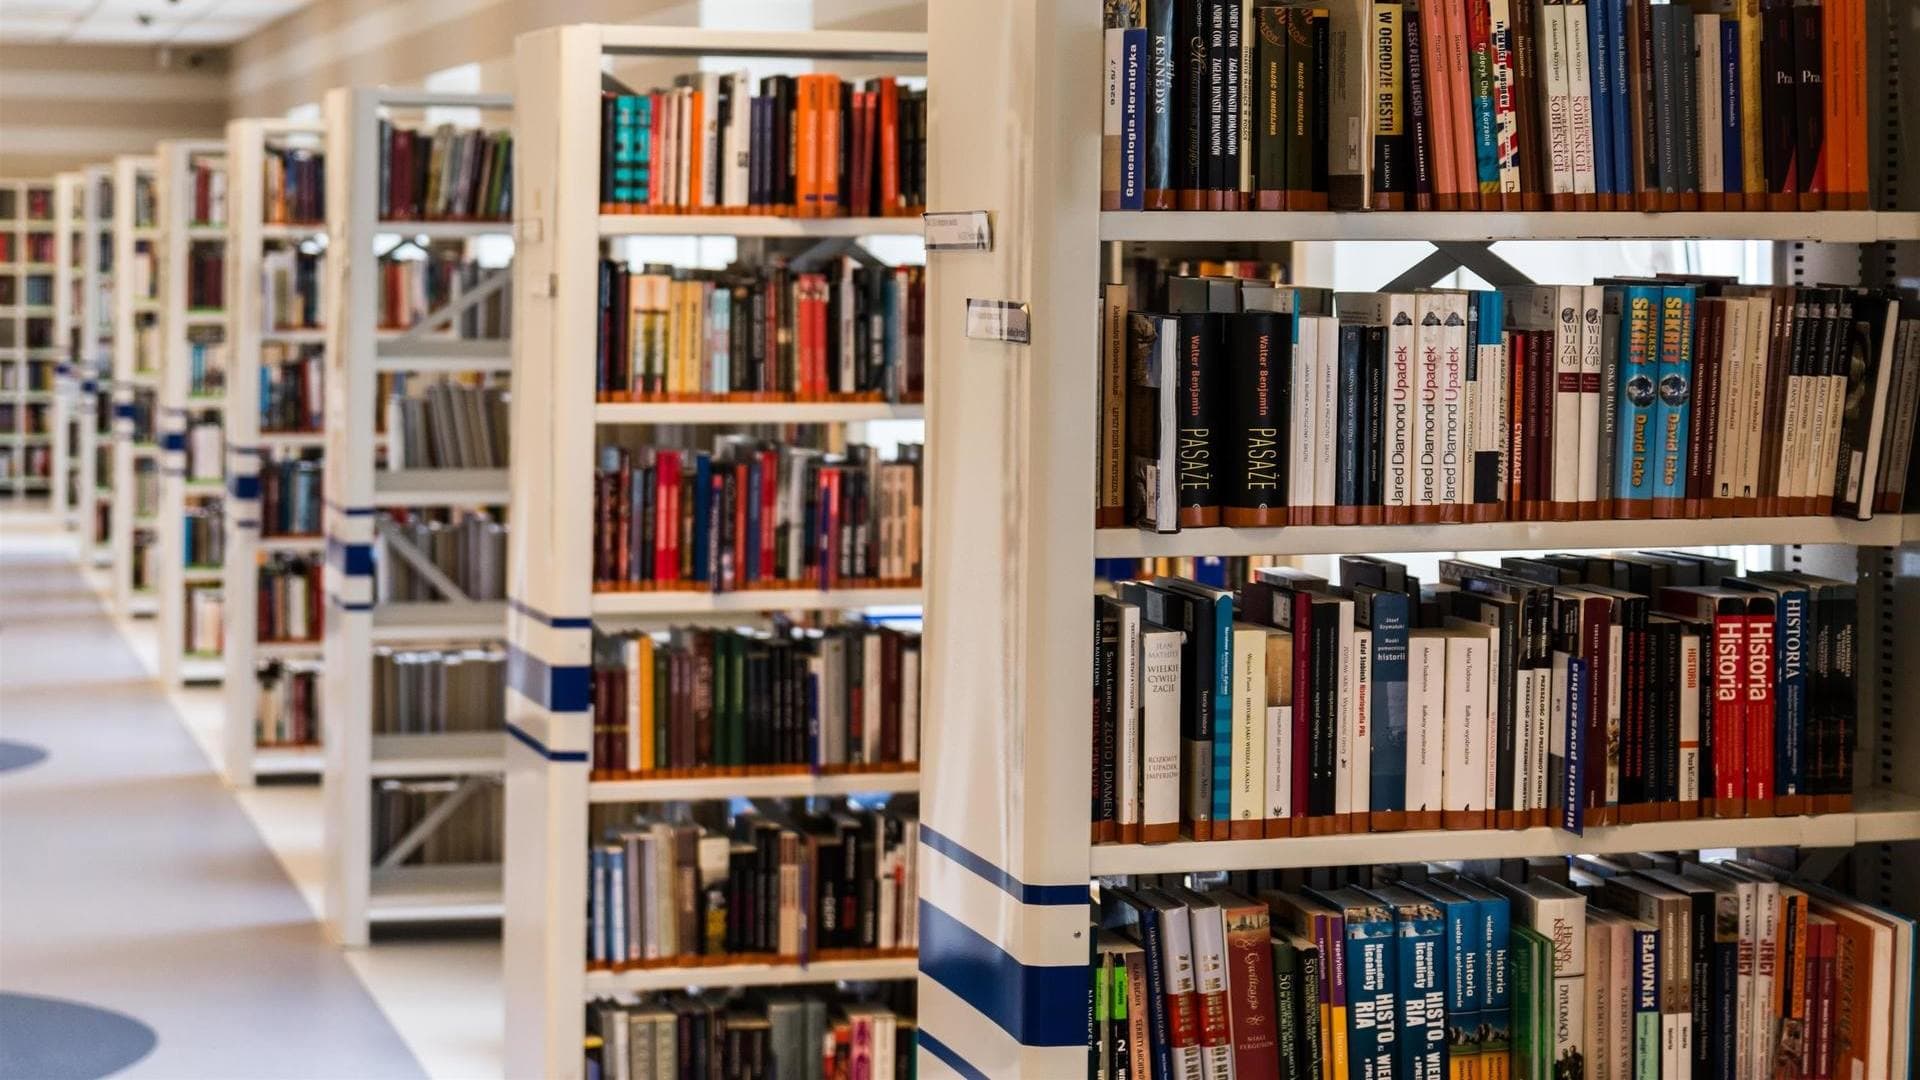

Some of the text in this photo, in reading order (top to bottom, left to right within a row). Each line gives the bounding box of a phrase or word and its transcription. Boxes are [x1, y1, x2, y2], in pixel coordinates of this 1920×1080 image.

[1212, 3, 1223, 48] ANDREW COOK
[1229, 3, 1238, 48] ANDREW COOK
[1155, 35, 1166, 115] KENNEDYS
[1378, 11, 1394, 132] W OGRODZIE BESTII
[1477, 43, 1488, 78] Fryderyk
[1495, 20, 1508, 106] TAJEMNICE WINDSORÓW
[1126, 44, 1138, 198] Genealogia.Heraldyka
[1211, 57, 1223, 156] ZAGŁADA DYNASTII ROMANOWÓW
[1228, 57, 1239, 156] ZAGŁADA DYNASTII ROMANOWÓW
[1269, 61, 1278, 136] MIŁOŚĆ NIEMOŻLIWA
[1296, 61, 1305, 136] MIŁOŚĆ NIEMOŻLIWA
[1482, 112, 1492, 147] Korzenie
[1551, 96, 1564, 173] SOBIESKICH
[1573, 96, 1586, 173] SOBIESKICH
[1563, 345, 1577, 355] ZA
[1588, 346, 1599, 355] ZA
[1630, 297, 1648, 364] SEKRET
[1662, 297, 1681, 363] SEKRET
[1189, 335, 1201, 416] Walter Benjamin
[1257, 335, 1269, 416] Walter Benjamin
[1560, 356, 1578, 367] CJE
[1607, 364, 1615, 392] OSKAR
[1391, 346, 1409, 507] Jared Diamond Upadek
[1420, 346, 1438, 507] Jared Diamond Upadek
[1442, 346, 1461, 506] Jared Diamond Upadek
[1606, 395, 1614, 433] HALECKI
[1181, 428, 1213, 491] PASAŻE
[1248, 428, 1281, 491] PASAŻE
[1513, 423, 1522, 484] CYWILIZACJE
[1631, 414, 1648, 487] David Icke
[1664, 413, 1681, 486] David Icke
[1378, 653, 1406, 661] historii
[1719, 622, 1742, 701] Historia
[1749, 622, 1772, 701] Historia
[1785, 599, 1801, 679] HISTORIA
[1105, 651, 1114, 712] SILVIA LIEBRICH
[1359, 656, 1367, 683] Stobiecki
[1539, 675, 1547, 716] PRZESZŁOŚĆ
[1687, 648, 1697, 689] HISTORIA
[1358, 684, 1366, 724] Historiografia
[1104, 720, 1113, 760] ZŁOTO
[1567, 663, 1579, 828] Historia powszechna
[1305, 958, 1315, 974] 50
[1335, 941, 1344, 986] repetytorium
[1363, 943, 1376, 991] licealisty
[1376, 943, 1384, 990] Kompendium
[1414, 942, 1426, 989] licealisty
[1426, 941, 1434, 988] Kompendium
[1496, 949, 1506, 994] historia
[1562, 926, 1573, 964] HENRY
[1244, 952, 1260, 1009] Cywilizacja
[1280, 975, 1291, 990] 50
[1466, 952, 1476, 997] historia
[1355, 1001, 1376, 1029] RIA
[1375, 993, 1395, 1044] HISTO
[1406, 999, 1426, 1028] RIA
[1425, 991, 1444, 1041] HISTO
[1557, 984, 1569, 1043] DYPLOMACJA
[1596, 988, 1605, 1044] TAJEMNICE
[1620, 987, 1628, 1042] TAJEMNICE
[1118, 1040, 1126, 1052] 2
